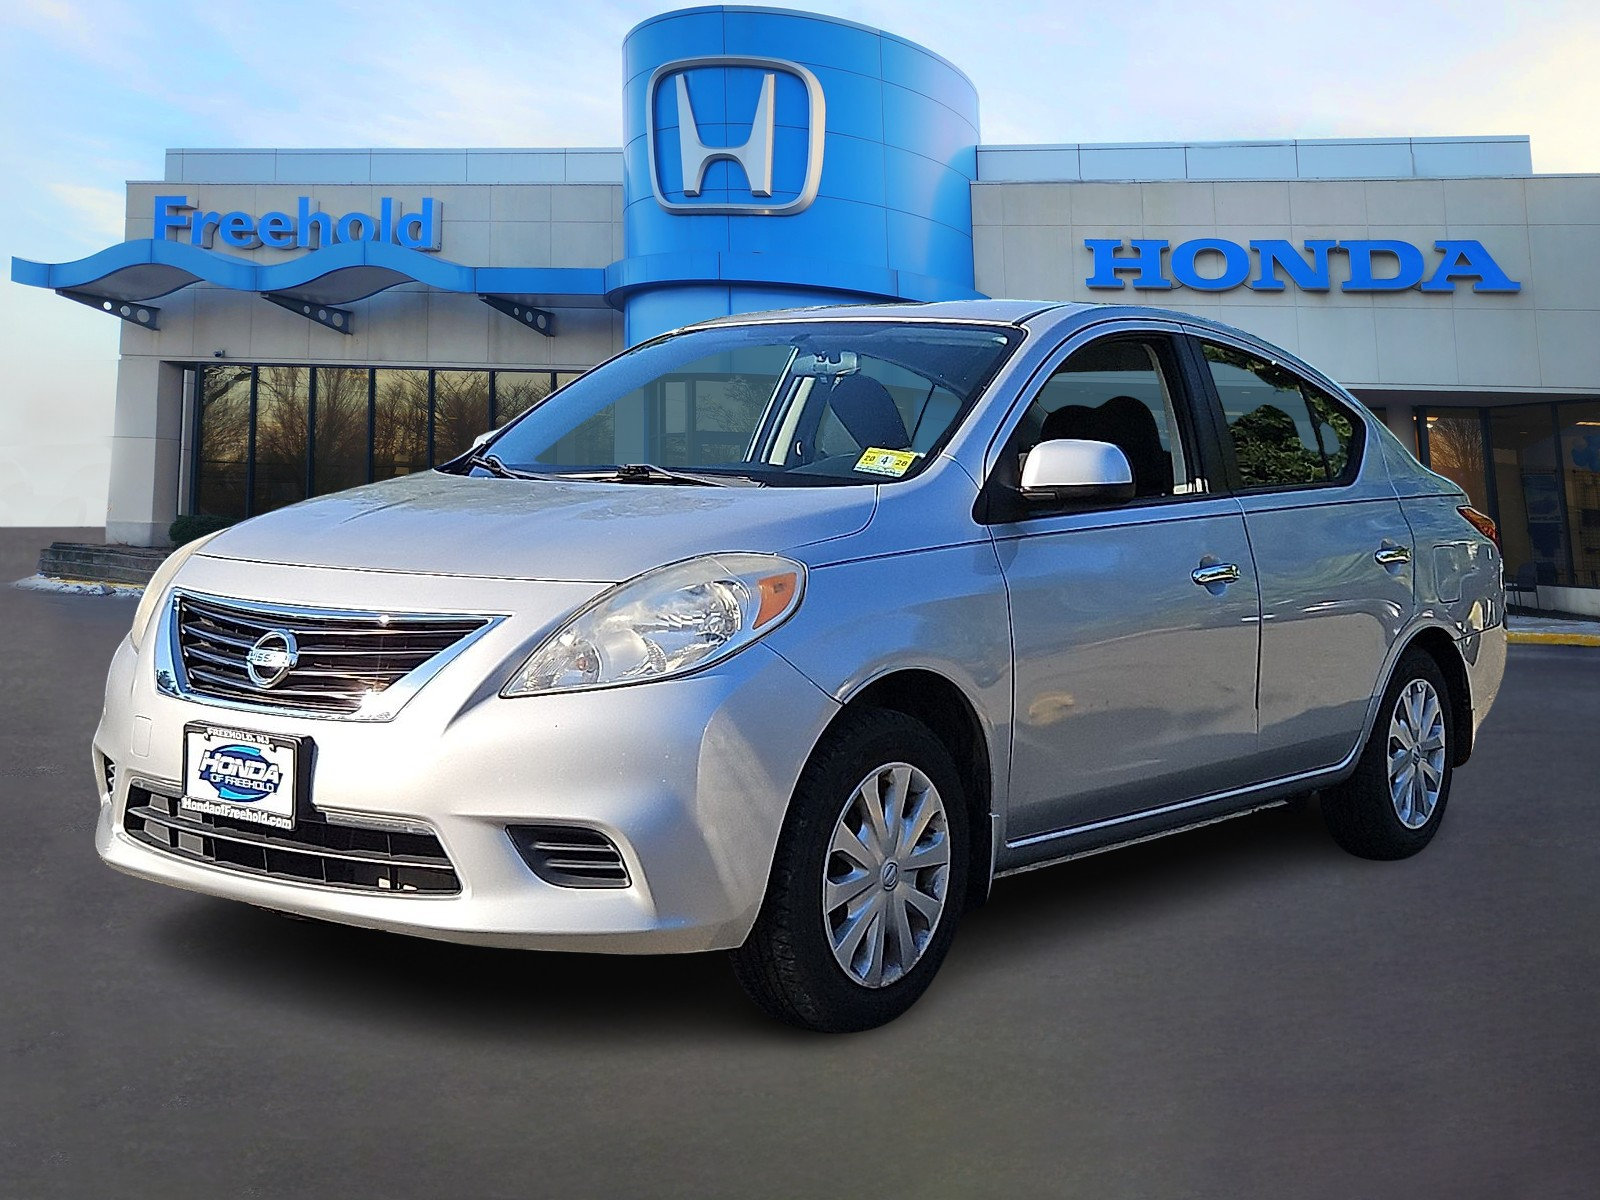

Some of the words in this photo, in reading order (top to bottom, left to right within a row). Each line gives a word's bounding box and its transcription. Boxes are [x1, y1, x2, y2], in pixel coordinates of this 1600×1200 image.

[153, 195, 437, 249] Freehold
[1084, 239, 1521, 293] HONDA
[199, 750, 281, 783] HONDA
[210, 773, 225, 783] OF
[225, 776, 275, 793] FREEHOLD
[181, 796, 292, 830] HondaofFreehold.com
